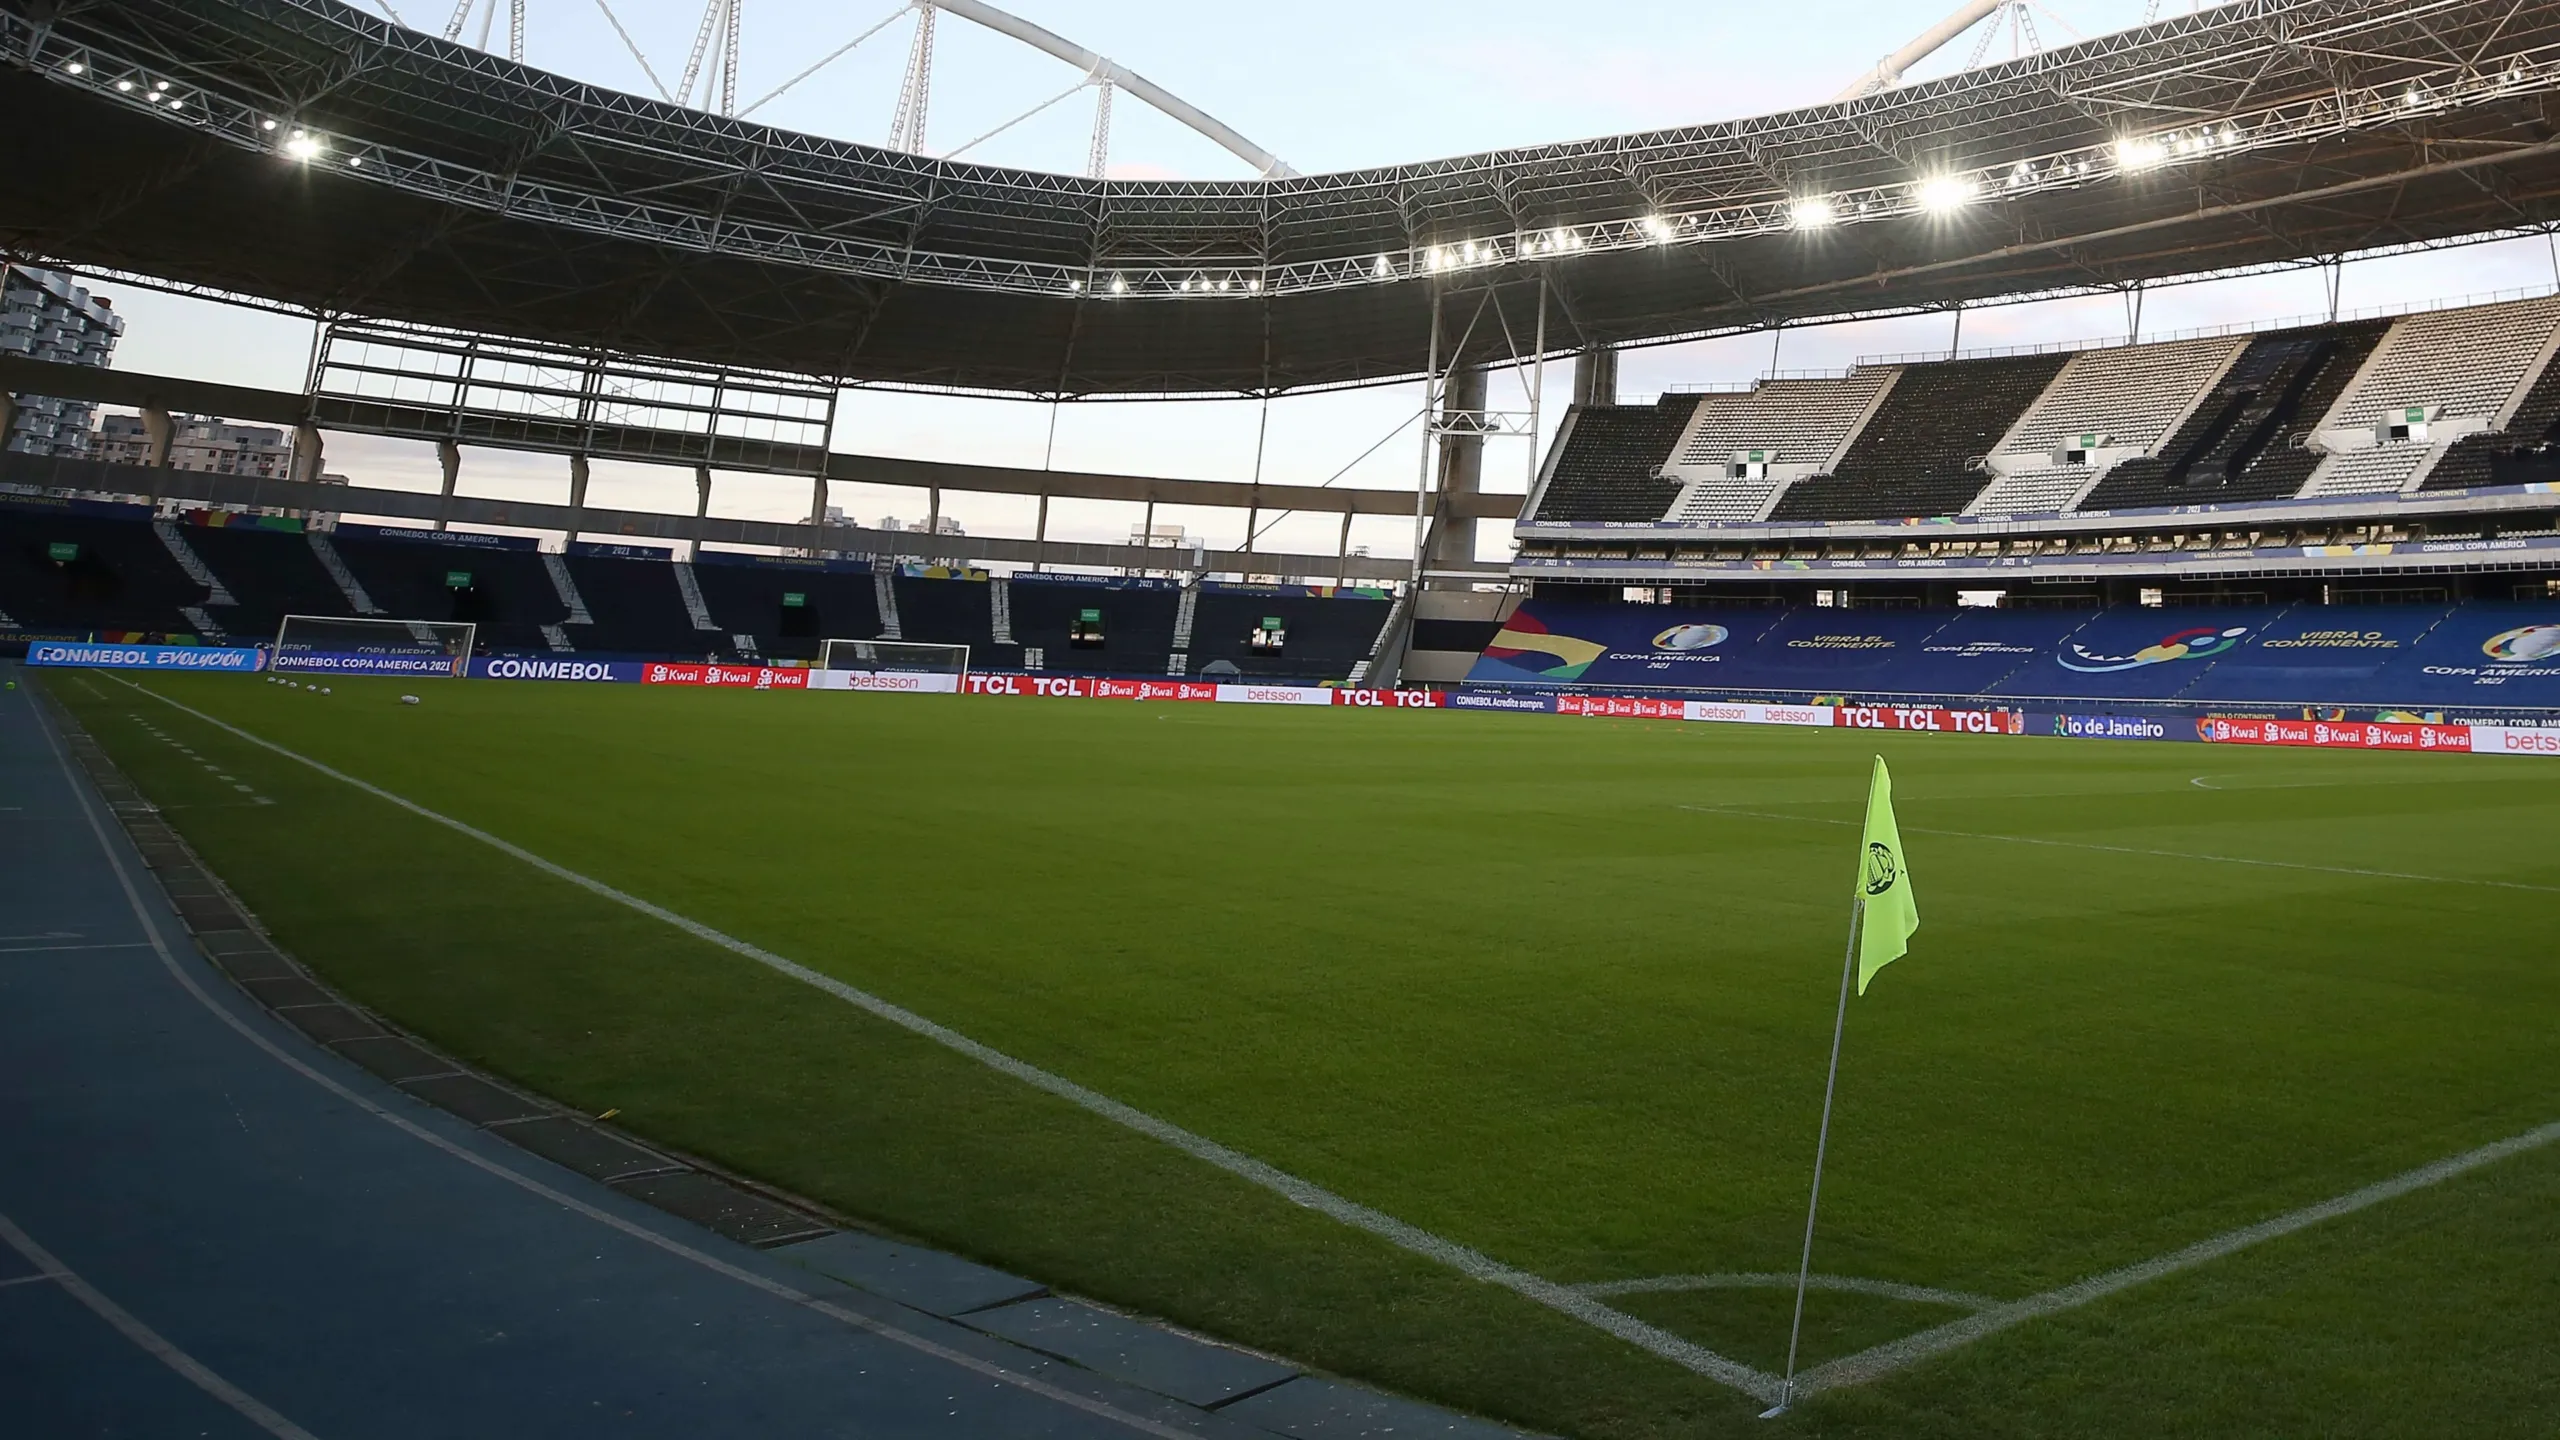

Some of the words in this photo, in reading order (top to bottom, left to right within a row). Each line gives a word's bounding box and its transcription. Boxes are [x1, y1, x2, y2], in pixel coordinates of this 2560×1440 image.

[2079, 511, 2110, 519] AMERICA
[380, 528, 428, 539] CONMEBOL
[431, 532, 456, 541] COPA
[458, 535, 499, 544] AMERICA
[2423, 543, 2464, 552] CONMEBOL
[2466, 541, 2488, 550] COPA
[2490, 540, 2527, 549] AMERICA
[1014, 573, 1053, 581] CONMEBOL
[1055, 574, 1074, 582] COPA
[1814, 635, 1862, 643] VIBRA
[2300, 631, 2359, 640] VIBRA
[2364, 631, 2382, 640] O
[2262, 639, 2399, 648] CONTINENTE.
[37, 648, 149, 664] CONMEBOL
[271, 656, 340, 668] CONMEBOL
[344, 658, 374, 669] COPA
[375, 660, 427, 671] AMERICA
[429, 661, 450, 671] 2021
[487, 659, 613, 681] CONMEBOL
[669, 668, 698, 682] Kwai
[722, 670, 750, 683] Kwai
[2423, 666, 2476, 676] COPA
[774, 672, 801, 685] Kwai
[849, 670, 918, 688] betsson
[969, 676, 1019, 694] TCL
[1034, 678, 1081, 697] TCL
[1111, 684, 1134, 696] Kwai
[1152, 686, 1173, 697] Kwai
[1191, 687, 1212, 699] Kwai
[1248, 687, 1302, 701] betsson
[1341, 690, 1383, 706] TCL
[1394, 691, 1436, 707] TCL
[1456, 695, 1491, 707] CONMEBOL
[1493, 696, 1518, 709] Acredite
[1519, 700, 1545, 711] sempre.
[1566, 702, 1580, 711] Kwai
[1590, 702, 1605, 712] Kwai
[1616, 703, 1630, 713] Kwai
[1641, 704, 1657, 714] Kwai
[1668, 705, 1683, 716] Kwai
[1700, 704, 1746, 720] betsson
[1765, 707, 1815, 722] betsson
[1841, 708, 1884, 728] TCL
[1895, 710, 1940, 731] TCL
[1950, 711, 1999, 733] TCL
[2085, 718, 2104, 734] de
[2106, 718, 2164, 738] Janeiro
[2232, 725, 2258, 739] Kwai
[2280, 727, 2308, 741] Kwai
[2331, 728, 2360, 743] Kwai
[2383, 730, 2413, 744] Kwai
[2438, 732, 2469, 746] Kwai
[2504, 731, 2560, 751] bets
